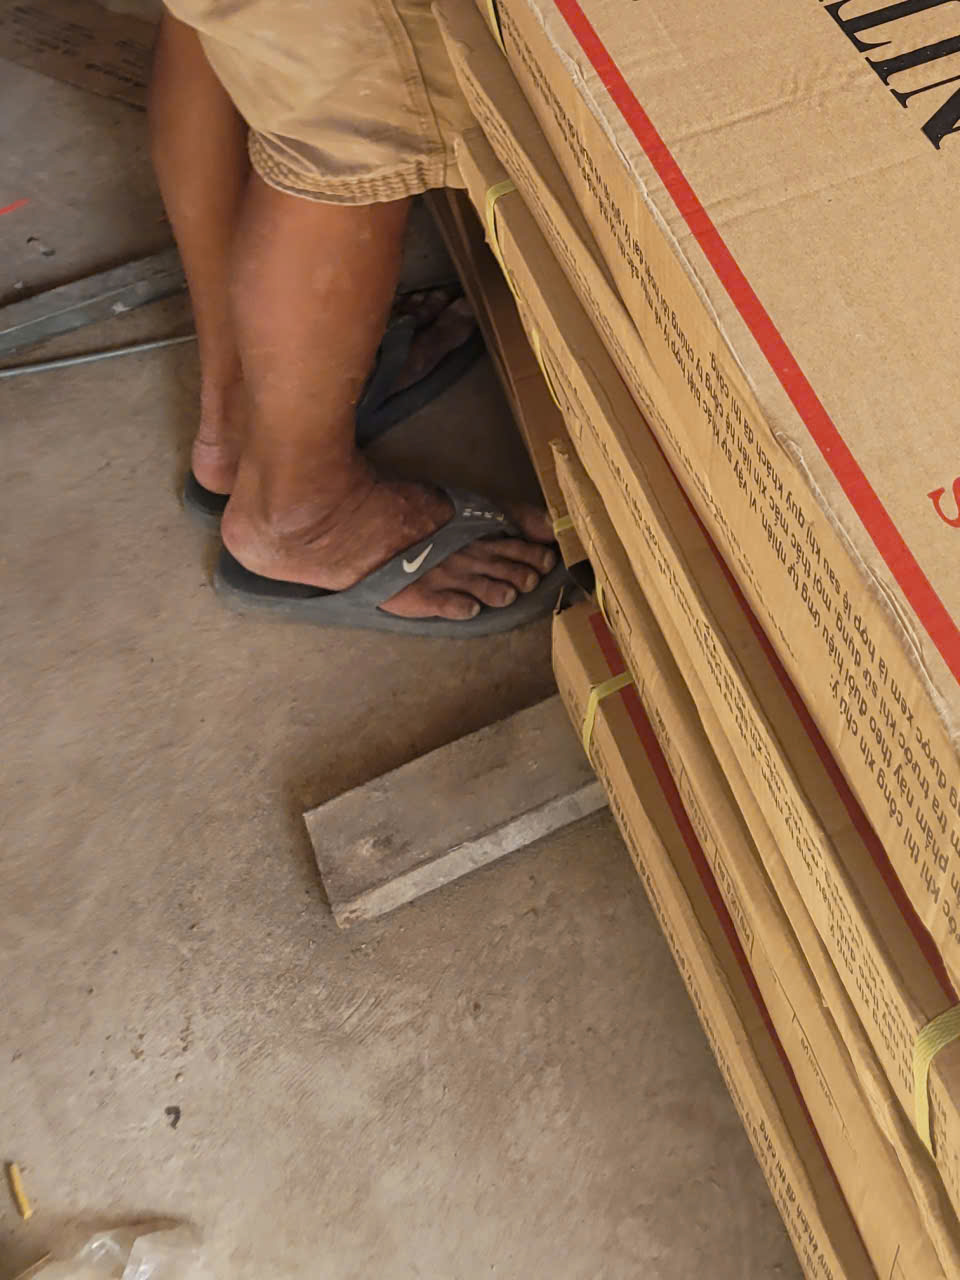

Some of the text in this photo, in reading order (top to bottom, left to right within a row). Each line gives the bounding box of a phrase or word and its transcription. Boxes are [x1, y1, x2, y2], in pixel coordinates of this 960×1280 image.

[681, 368, 706, 407] biệt
[698, 371, 727, 419] công
[702, 349, 734, 400] công.
[697, 398, 724, 444] khác
[717, 414, 744, 443] hệ
[726, 395, 745, 426] thi
[738, 417, 756, 446] đã
[715, 438, 738, 464] sự
[730, 438, 758, 473] liên
[749, 441, 788, 497] khách
[726, 462, 754, 494] vậy
[747, 467, 770, 496] xin
[760, 494, 793, 537] mắc
[779, 490, 809, 530] quý
[751, 507, 793, 566] nhiên,
[779, 532, 816, 581] thắc
[799, 525, 829, 565] khi
[783, 562, 806, 590] tự
[807, 571, 836, 610] mọi
[817, 557, 843, 594] sau
[793, 581, 826, 628] ứng
[835, 591, 858, 620] lệ
[816, 624, 849, 673] hiệu
[826, 607, 867, 670] dụng,
[848, 612, 880, 659] hợp
[822, 671, 842, 698] ý:
[859, 667, 879, 696] sử
[871, 654, 891, 682] là
[833, 695, 862, 738] chú
[873, 695, 901, 738] khi
[885, 677, 915, 725] xem
[855, 737, 879, 774] xin
[862, 713, 897, 770] theo
[909, 723, 951, 792] được
[892, 729, 933, 799] trước
[869, 766, 908, 830] công
[888, 761, 919, 812] này
[926, 793, 951, 835] tra
[899, 824, 924, 865] thi
[909, 805, 952, 878] phẩm
[916, 859, 943, 905] khi
